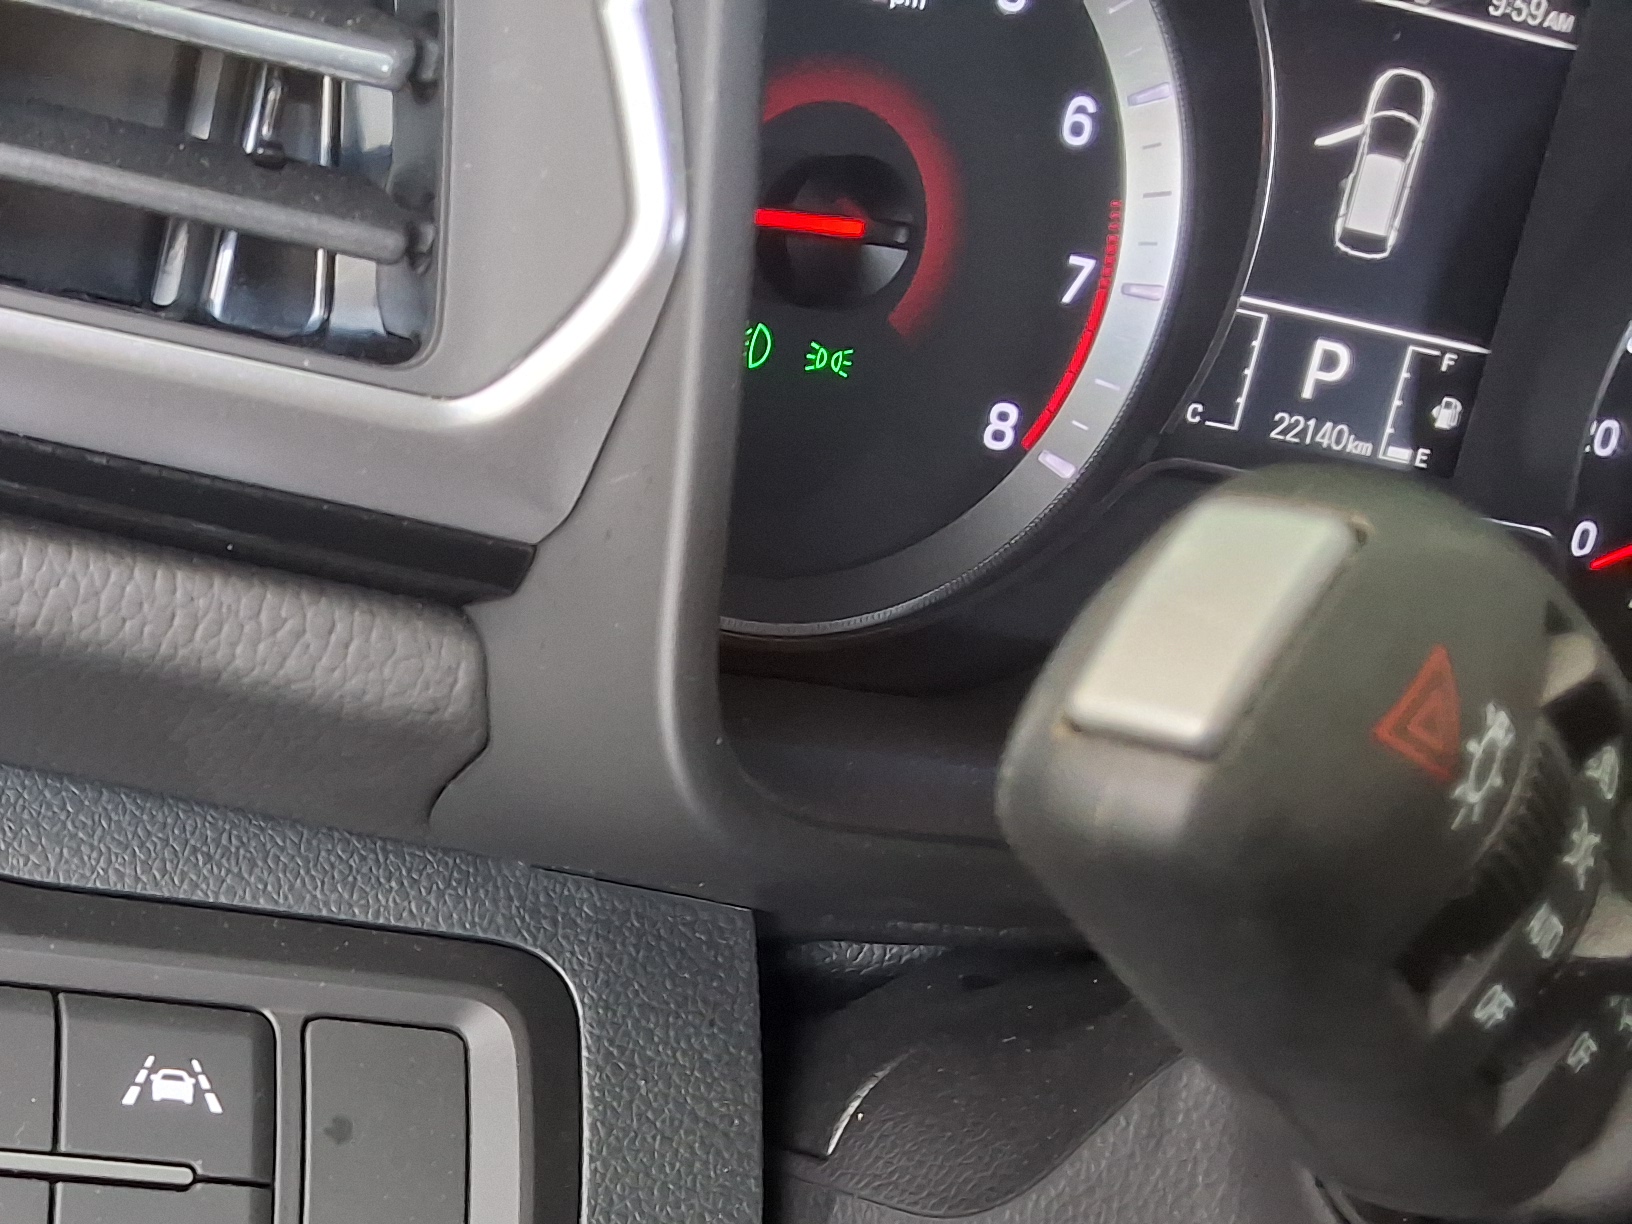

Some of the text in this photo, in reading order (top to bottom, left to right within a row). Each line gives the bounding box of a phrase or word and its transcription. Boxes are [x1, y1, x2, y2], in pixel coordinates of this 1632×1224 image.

[1060, 94, 1099, 147] 6
[1060, 254, 1097, 304] 7
[1300, 337, 1352, 400] P
[1440, 352, 1459, 372] F
[982, 402, 1020, 452] 8
[1185, 402, 1205, 424] C
[1414, 447, 1432, 469] E
[1585, 418, 1621, 458] 0
[1570, 519, 1598, 557] 0
